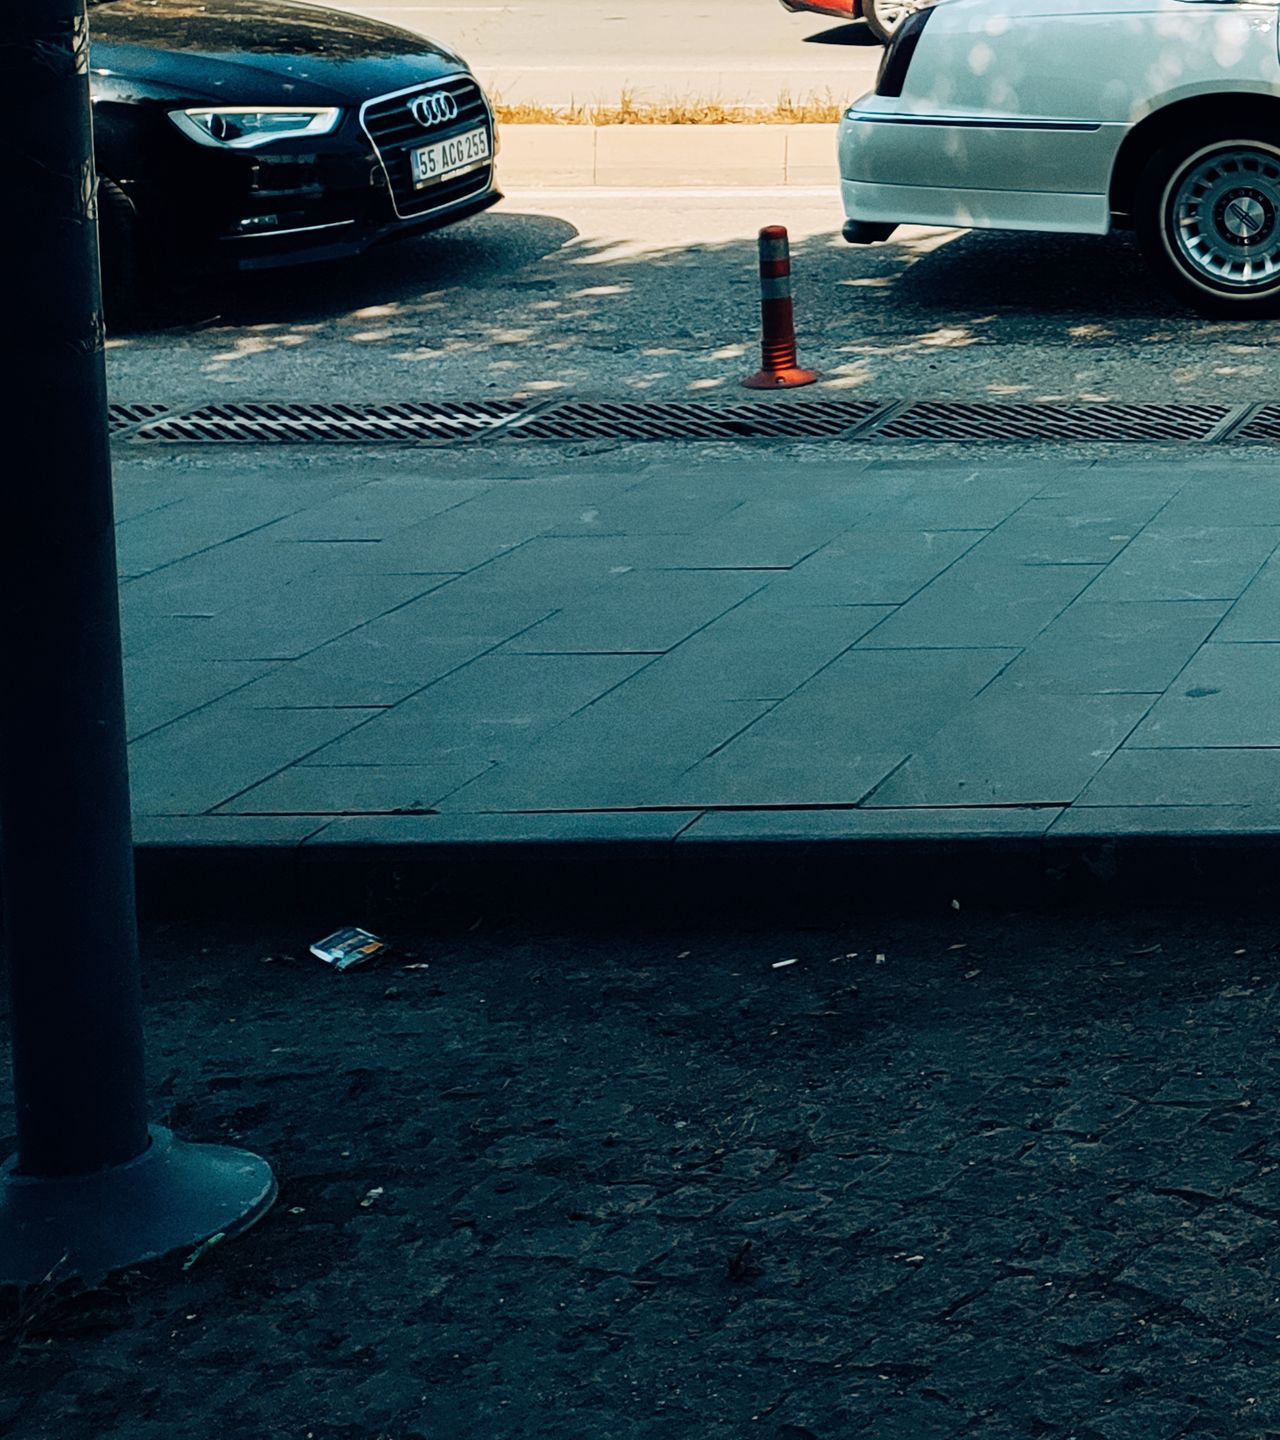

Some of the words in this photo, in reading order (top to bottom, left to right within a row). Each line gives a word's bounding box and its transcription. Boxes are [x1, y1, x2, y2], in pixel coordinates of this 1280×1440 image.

[419, 148, 436, 176] 55
[442, 140, 464, 169] ACG
[465, 131, 487, 159] 255
